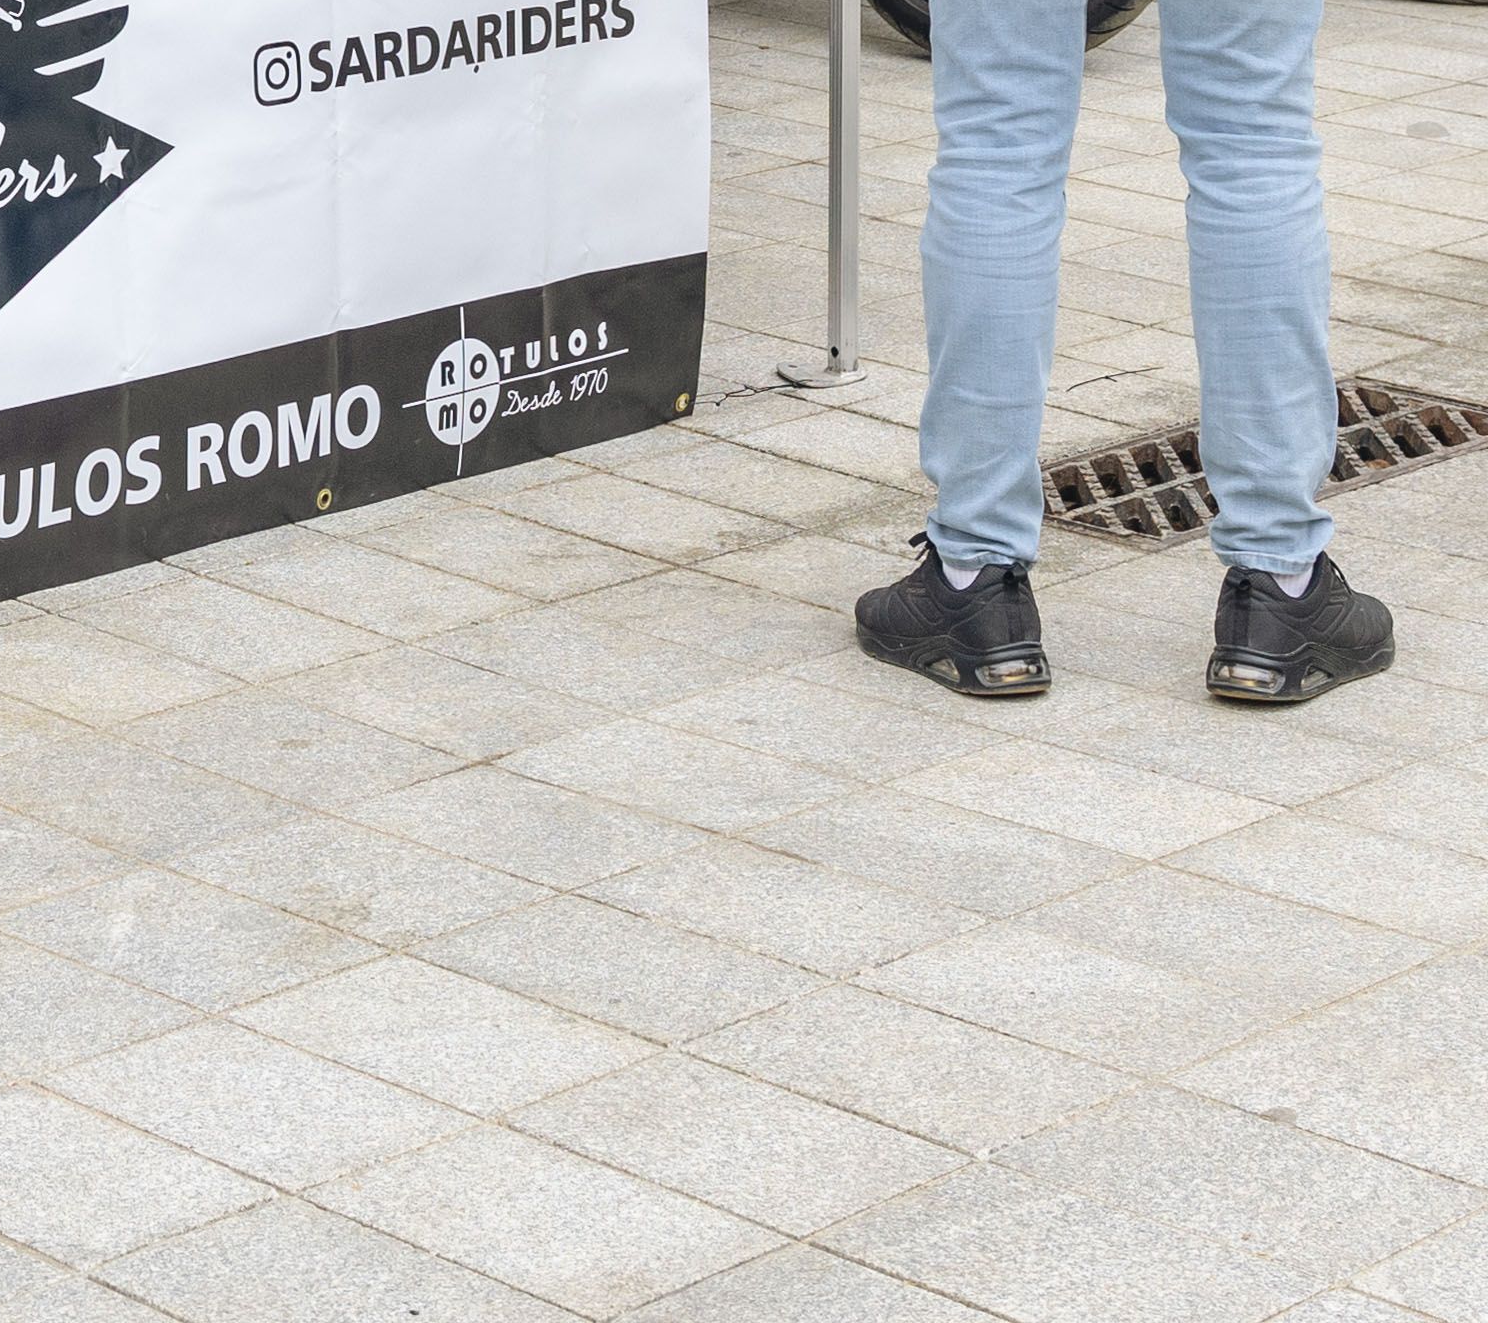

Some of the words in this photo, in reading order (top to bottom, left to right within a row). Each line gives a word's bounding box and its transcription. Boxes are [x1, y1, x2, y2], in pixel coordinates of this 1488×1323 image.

[501, 381, 563, 417] Desde
[570, 367, 608, 401] 1970
[186, 384, 382, 491] ROMO
